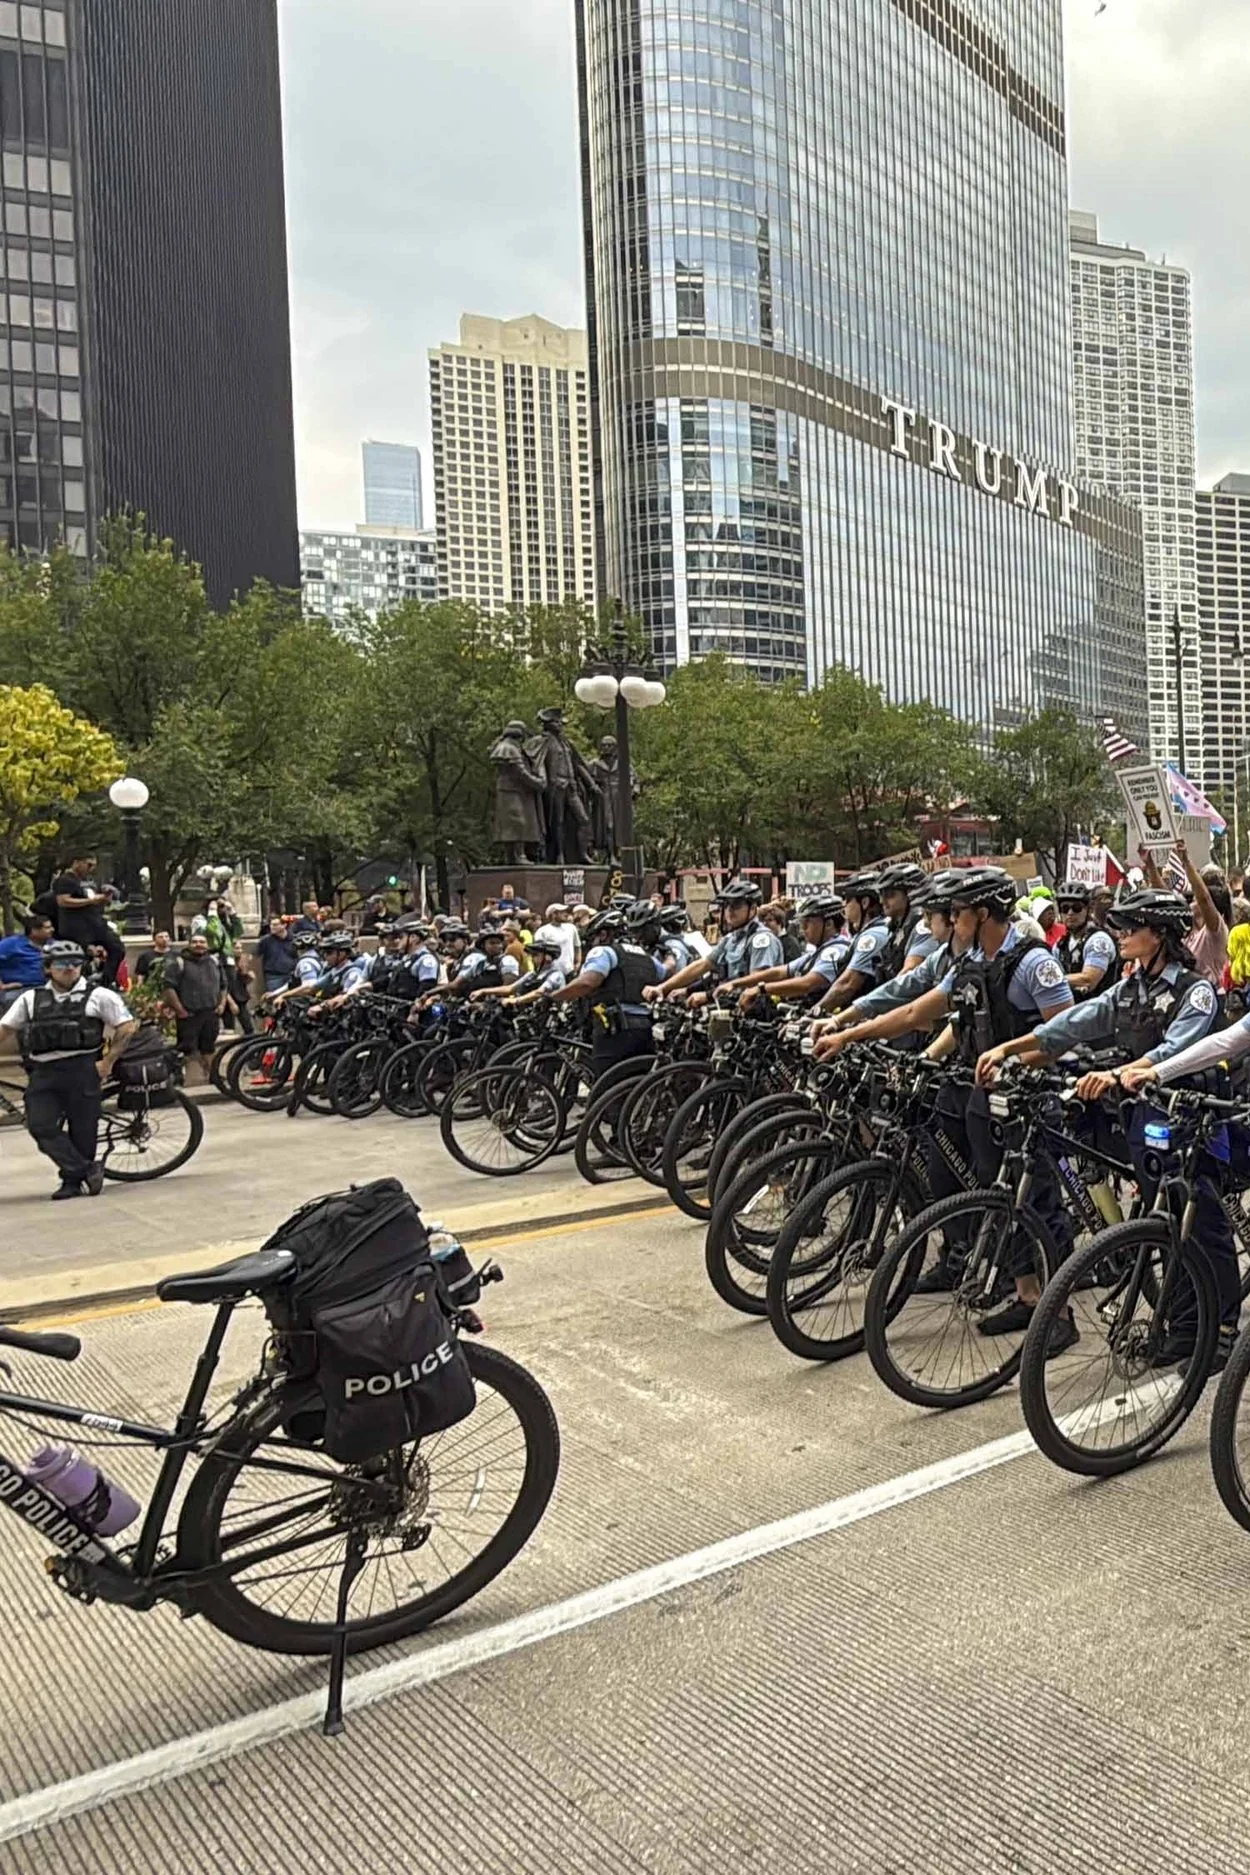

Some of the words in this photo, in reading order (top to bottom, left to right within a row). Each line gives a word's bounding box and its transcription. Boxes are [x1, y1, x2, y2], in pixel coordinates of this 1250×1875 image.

[881, 396, 1080, 528] TRUMP
[1146, 784, 1158, 793] YOU
[1070, 846, 1082, 861] I
[1145, 831, 1171, 841] FASCISM
[788, 882, 832, 897] TROOPS
[935, 1127, 967, 1174] CHICAGO
[1064, 1167, 1093, 1214] CHICAGO
[345, 1341, 453, 1399] POLICE
[12, 1489, 90, 1555] POLICE
